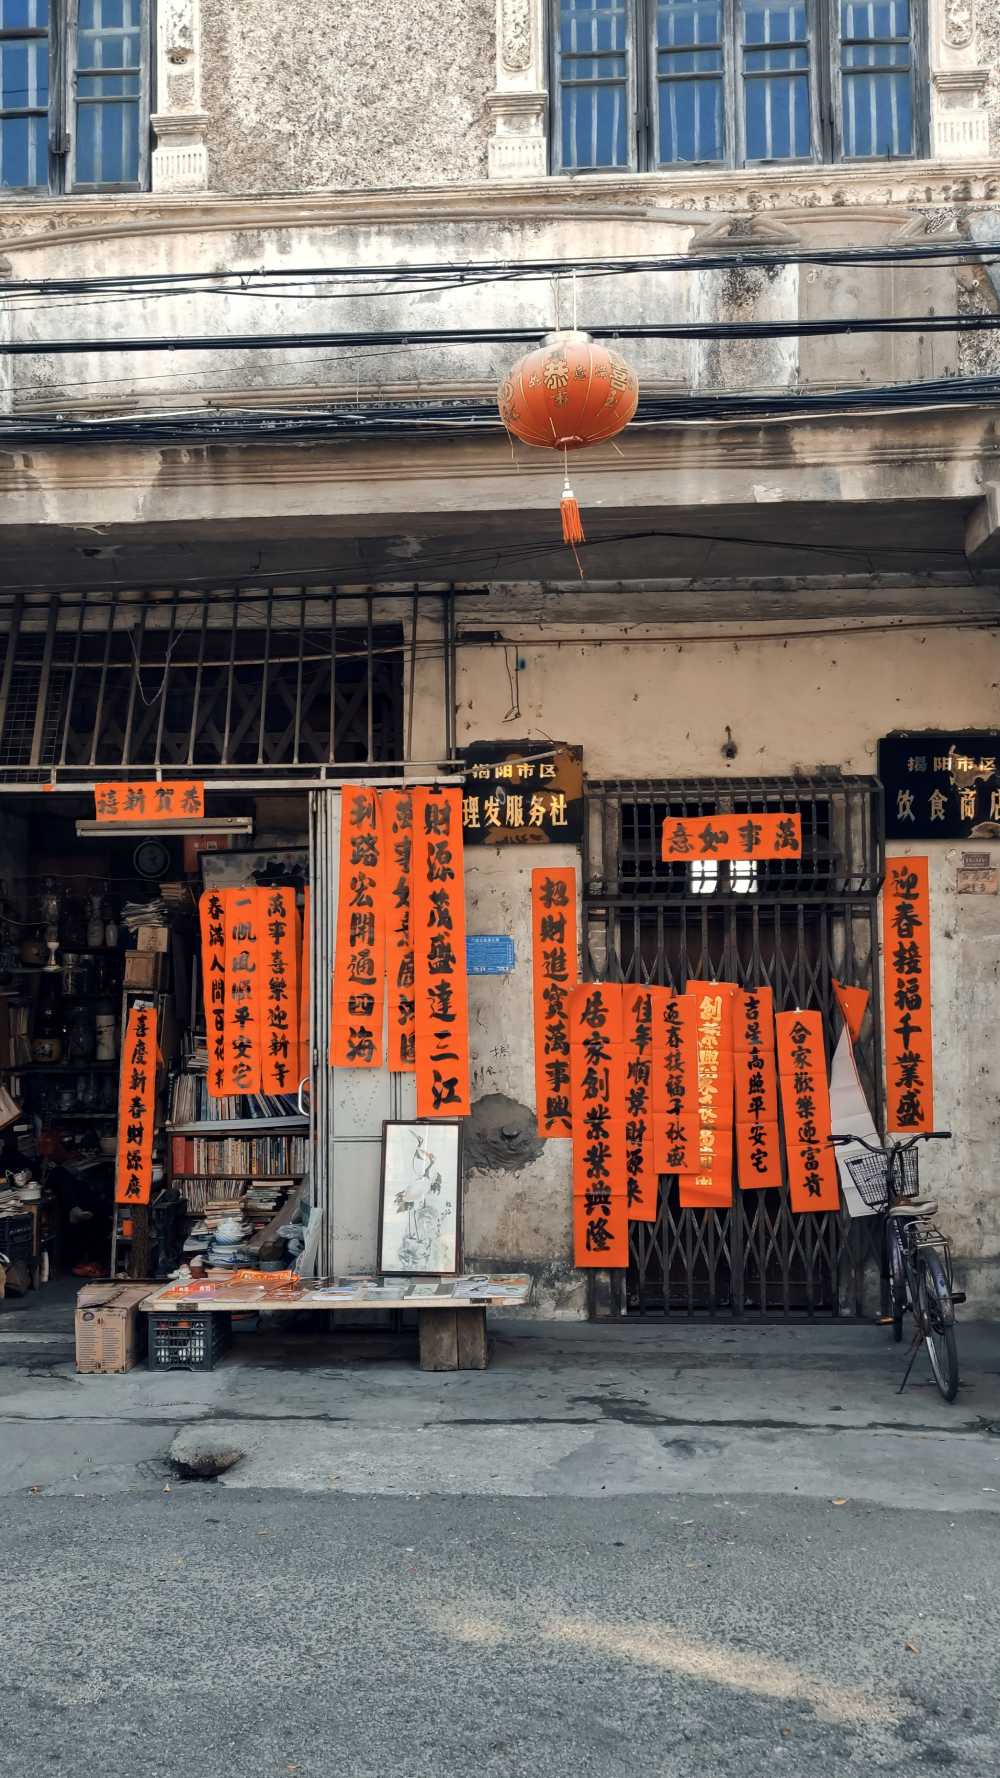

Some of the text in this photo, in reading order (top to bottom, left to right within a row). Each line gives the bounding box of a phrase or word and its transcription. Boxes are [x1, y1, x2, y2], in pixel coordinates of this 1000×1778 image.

[462, 794, 568, 828] 理发服务社
